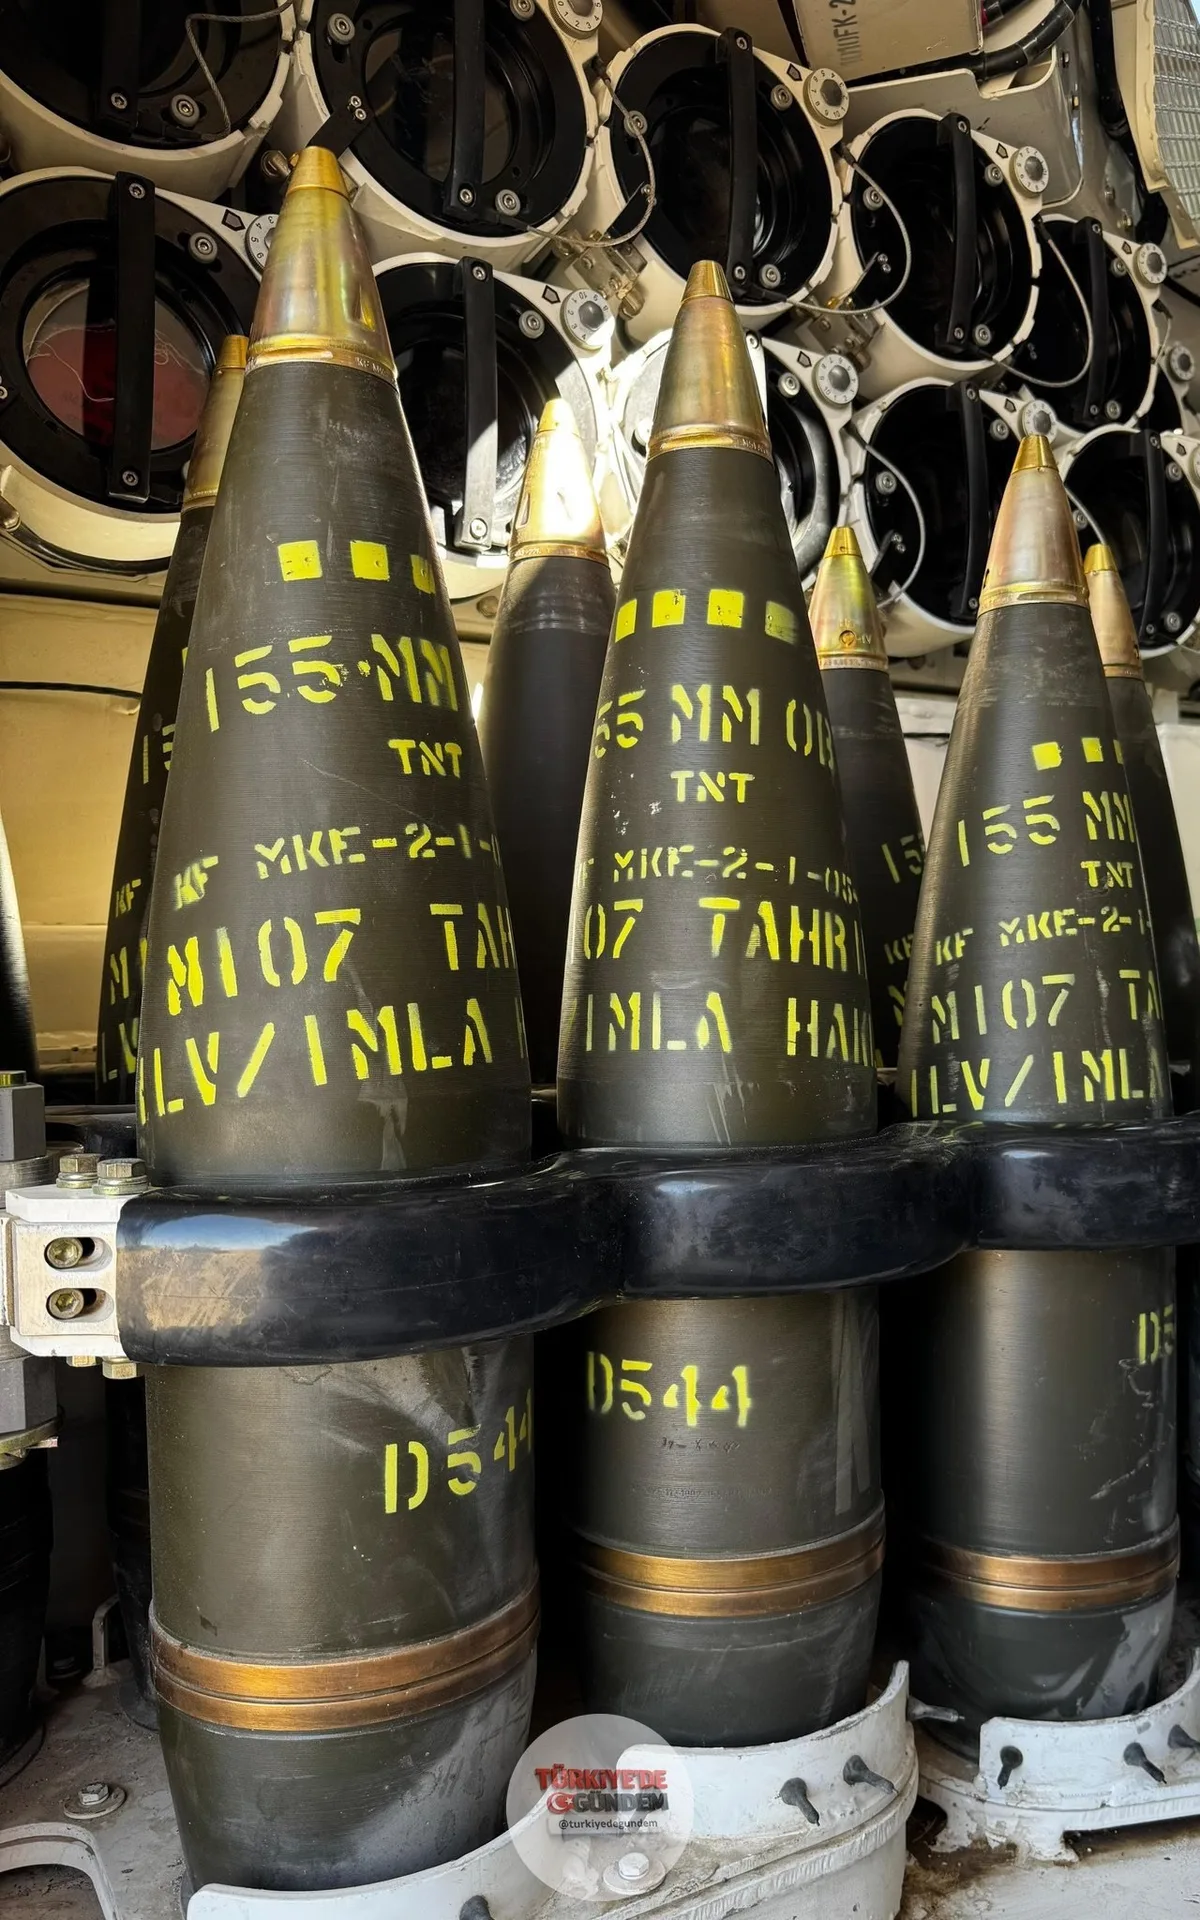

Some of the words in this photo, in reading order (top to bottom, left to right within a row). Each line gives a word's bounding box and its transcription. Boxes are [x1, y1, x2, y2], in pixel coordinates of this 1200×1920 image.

[205, 635, 340, 732] 155
[371, 633, 458, 711] MM
[671, 684, 761, 746] MM
[388, 739, 462, 778] TNT
[670, 770, 755, 803] TNT
[958, 795, 1060, 867] 155
[174, 856, 218, 910] KF
[1080, 860, 1133, 889] TNT
[167, 908, 361, 1016] M107
[935, 927, 973, 966] KF
[932, 973, 1075, 1045] M107
[587, 1351, 751, 1428] D544
[384, 1388, 532, 1514] D544
